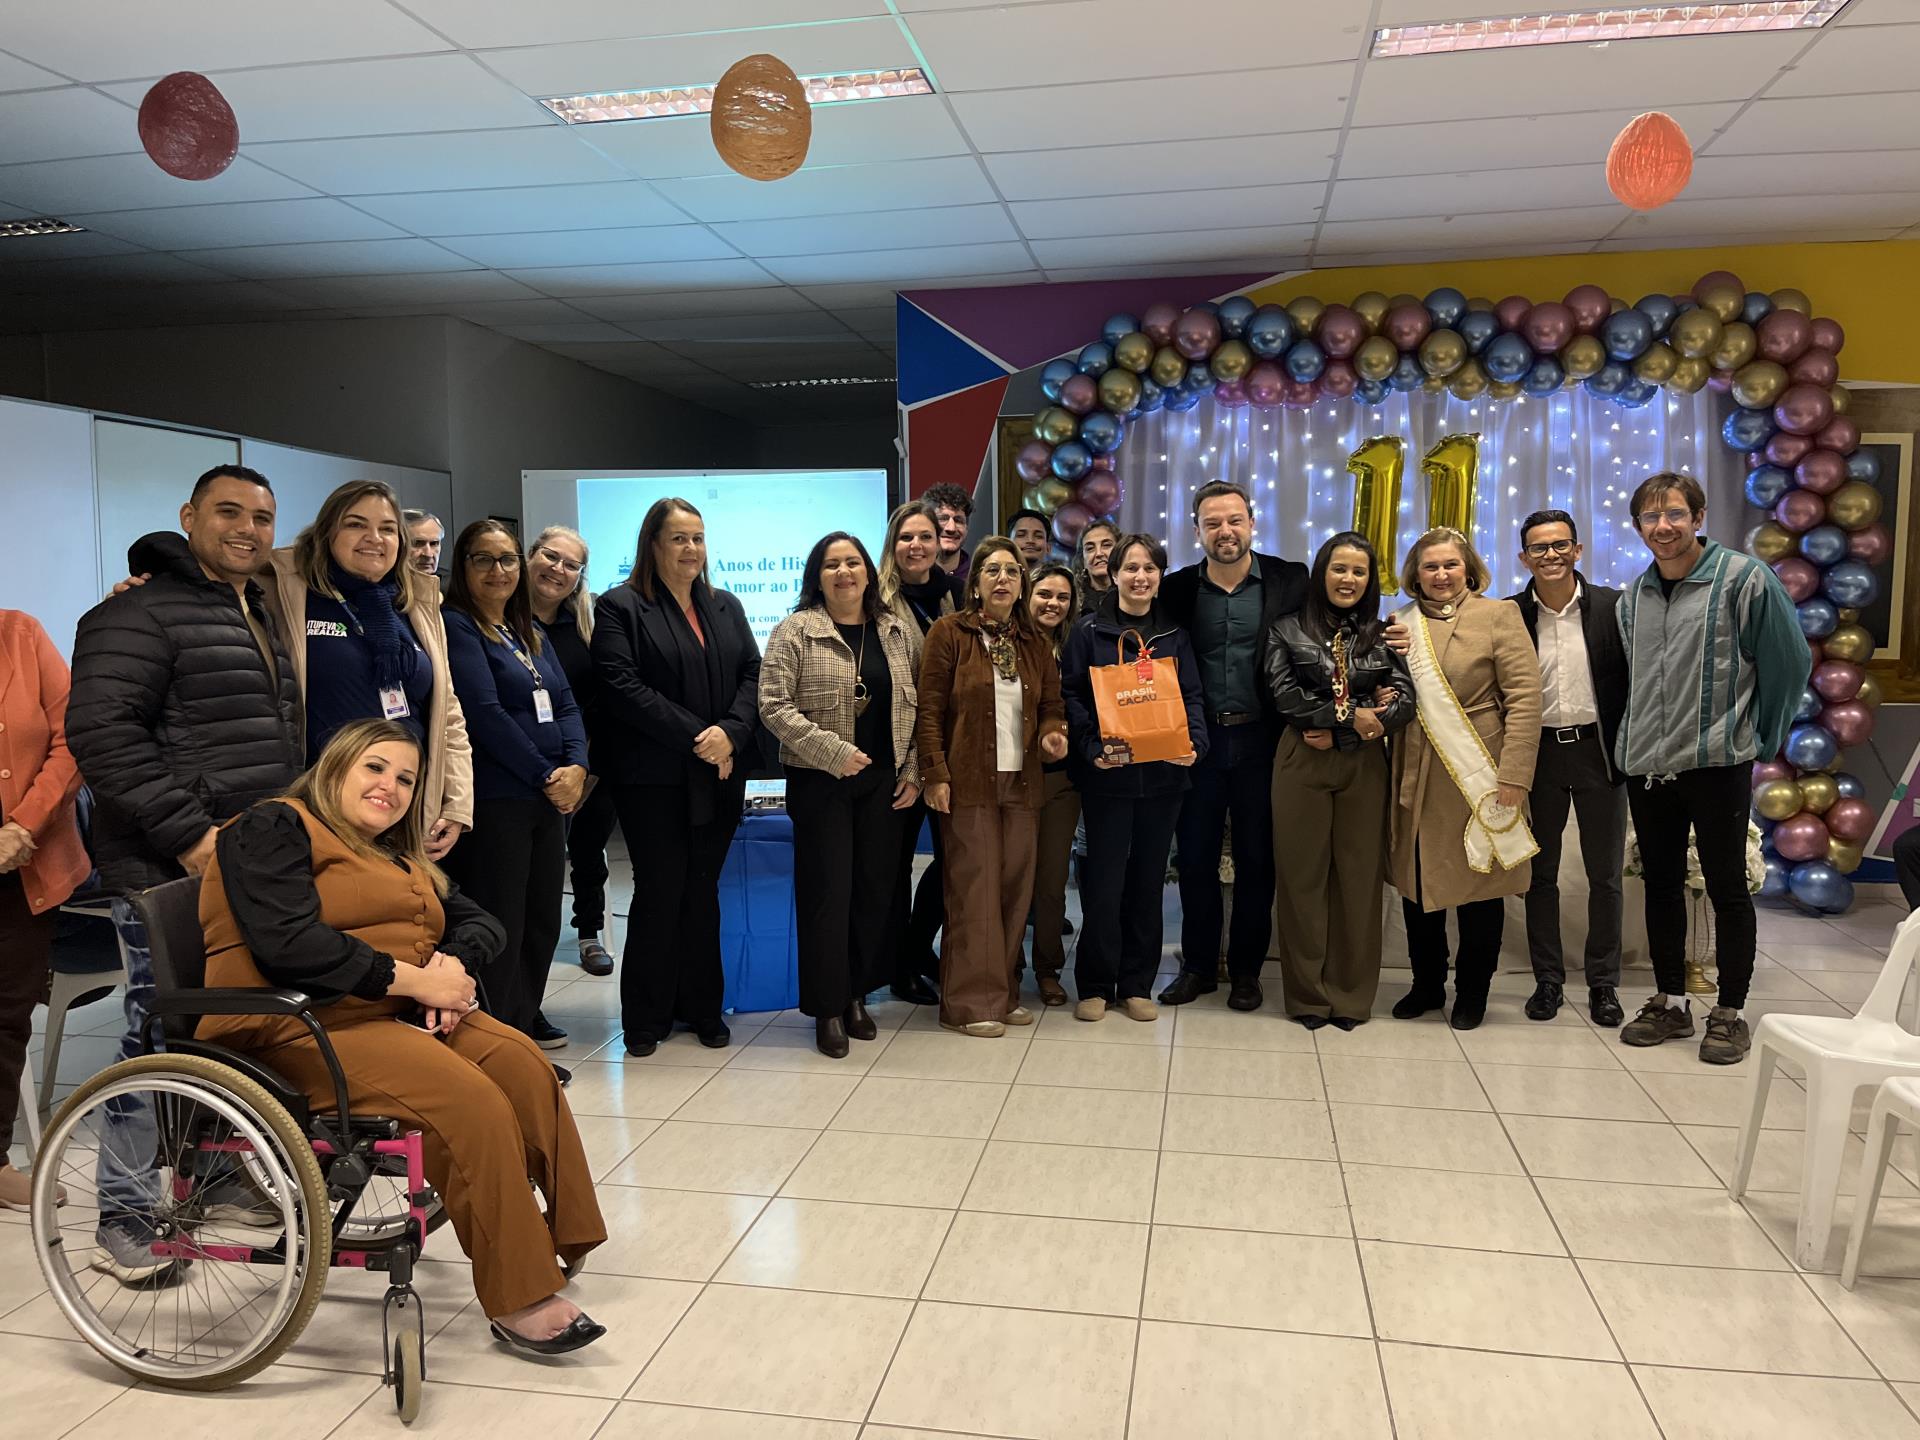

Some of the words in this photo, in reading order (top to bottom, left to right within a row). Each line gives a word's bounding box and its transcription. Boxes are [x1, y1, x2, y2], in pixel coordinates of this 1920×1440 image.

[1346, 432, 1481, 596] 11
[714, 558, 753, 572] Anos
[758, 557, 776, 571] de
[781, 557, 806, 571] His
[722, 580, 766, 593] Amor
[770, 582, 788, 593] ao
[306, 619, 337, 631] ITUPEVA
[758, 615, 780, 623] com
[306, 628, 348, 638] REALIZA
[1116, 686, 1157, 700] BRASIL
[1118, 694, 1157, 707] CACAU
